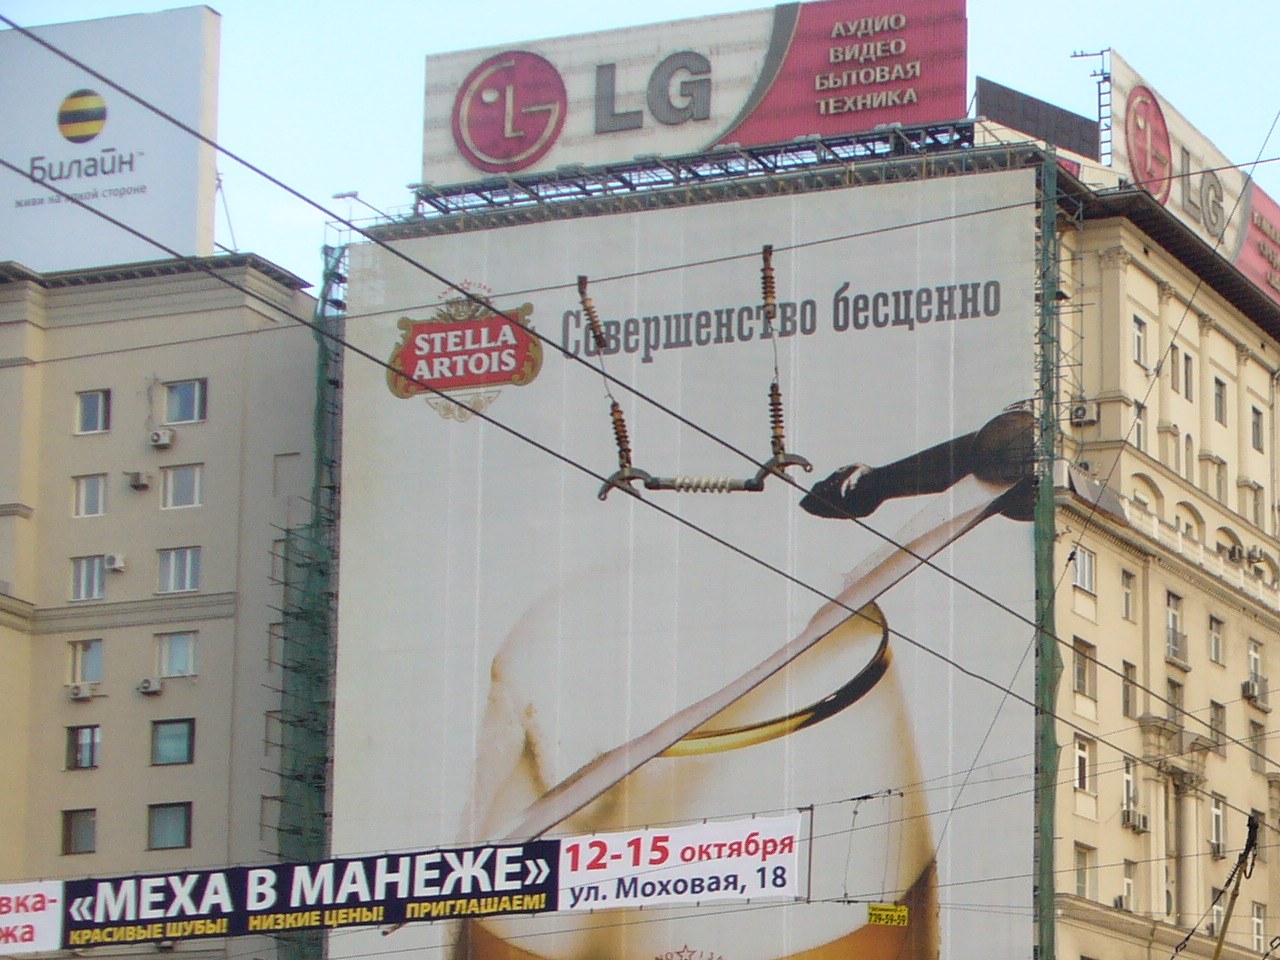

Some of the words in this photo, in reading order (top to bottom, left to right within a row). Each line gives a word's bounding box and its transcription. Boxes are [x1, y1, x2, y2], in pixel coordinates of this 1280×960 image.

[830, 13, 907, 38] АУДИО
[829, 38, 907, 63] ВИДЕО
[595, 50, 713, 135] LG
[815, 60, 921, 91] БЫТОВАЯ
[816, 86, 919, 116] ТЕХНИКА
[30, 148, 134, 183] Билайн
[1181, 145, 1225, 245] LG
[414, 324, 517, 356] STELLA
[561, 298, 817, 364] Совершенство
[832, 279, 1002, 333] бесценно
[412, 349, 517, 381] ARTOIS
[565, 835, 671, 873] 12-15
[680, 831, 795, 863] октября
[69, 872, 234, 924] «МЕХА
[246, 868, 277, 912] В
[289, 847, 551, 908] МАНЕЖЕ»
[569, 883, 608, 909] ул.
[616, 873, 746, 901] Моховая,
[756, 865, 787, 890] 18
[69, 923, 164, 946] КРАСИВЫЕ
[166, 918, 229, 937] ШУБЫ!
[248, 910, 322, 932] НИЗКИЕ
[325, 906, 384, 929] ЦЕНЫ!
[406, 893, 547, 919] ПРИГЛАШАЕМ!
